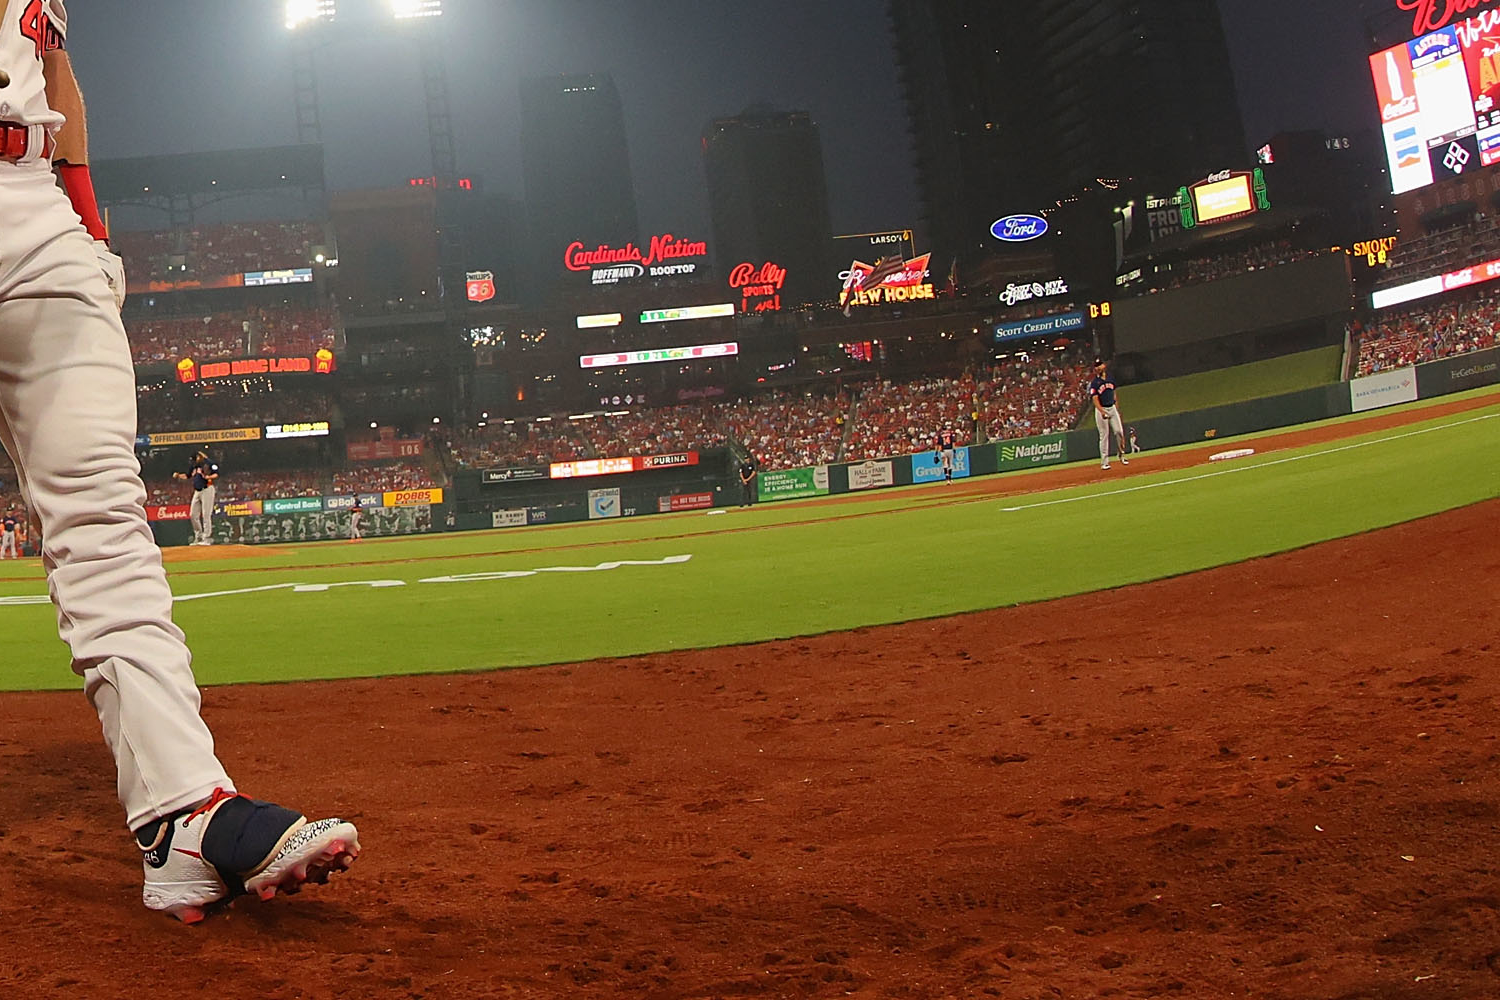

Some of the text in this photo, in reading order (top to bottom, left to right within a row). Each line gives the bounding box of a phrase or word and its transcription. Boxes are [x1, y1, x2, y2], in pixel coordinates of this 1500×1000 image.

[1003, 218, 1037, 237] Ford
[564, 233, 707, 272] Cardinals Nation
[649, 263, 696, 277] ROOFTOP
[729, 261, 787, 289] Bally
[468, 283, 490, 298] 66
[742, 284, 775, 298] SPORTS
[884, 283, 935, 302] HOUSE
[996, 316, 1082, 338] SCOTT CREDIT UNION
[231, 359, 269, 375] MAC
[268, 357, 311, 373] LAND
[154, 432, 183, 444] OFFICIAL
[185, 429, 218, 442] GRADUATE
[220, 427, 247, 439] SCHOOL
[400, 444, 421, 456] 106
[1015, 440, 1063, 458] National
[653, 455, 687, 465] PURINA
[395, 490, 431, 501] DOBBS
[223, 503, 248, 513] planet
[274, 497, 322, 511] Central Bank
